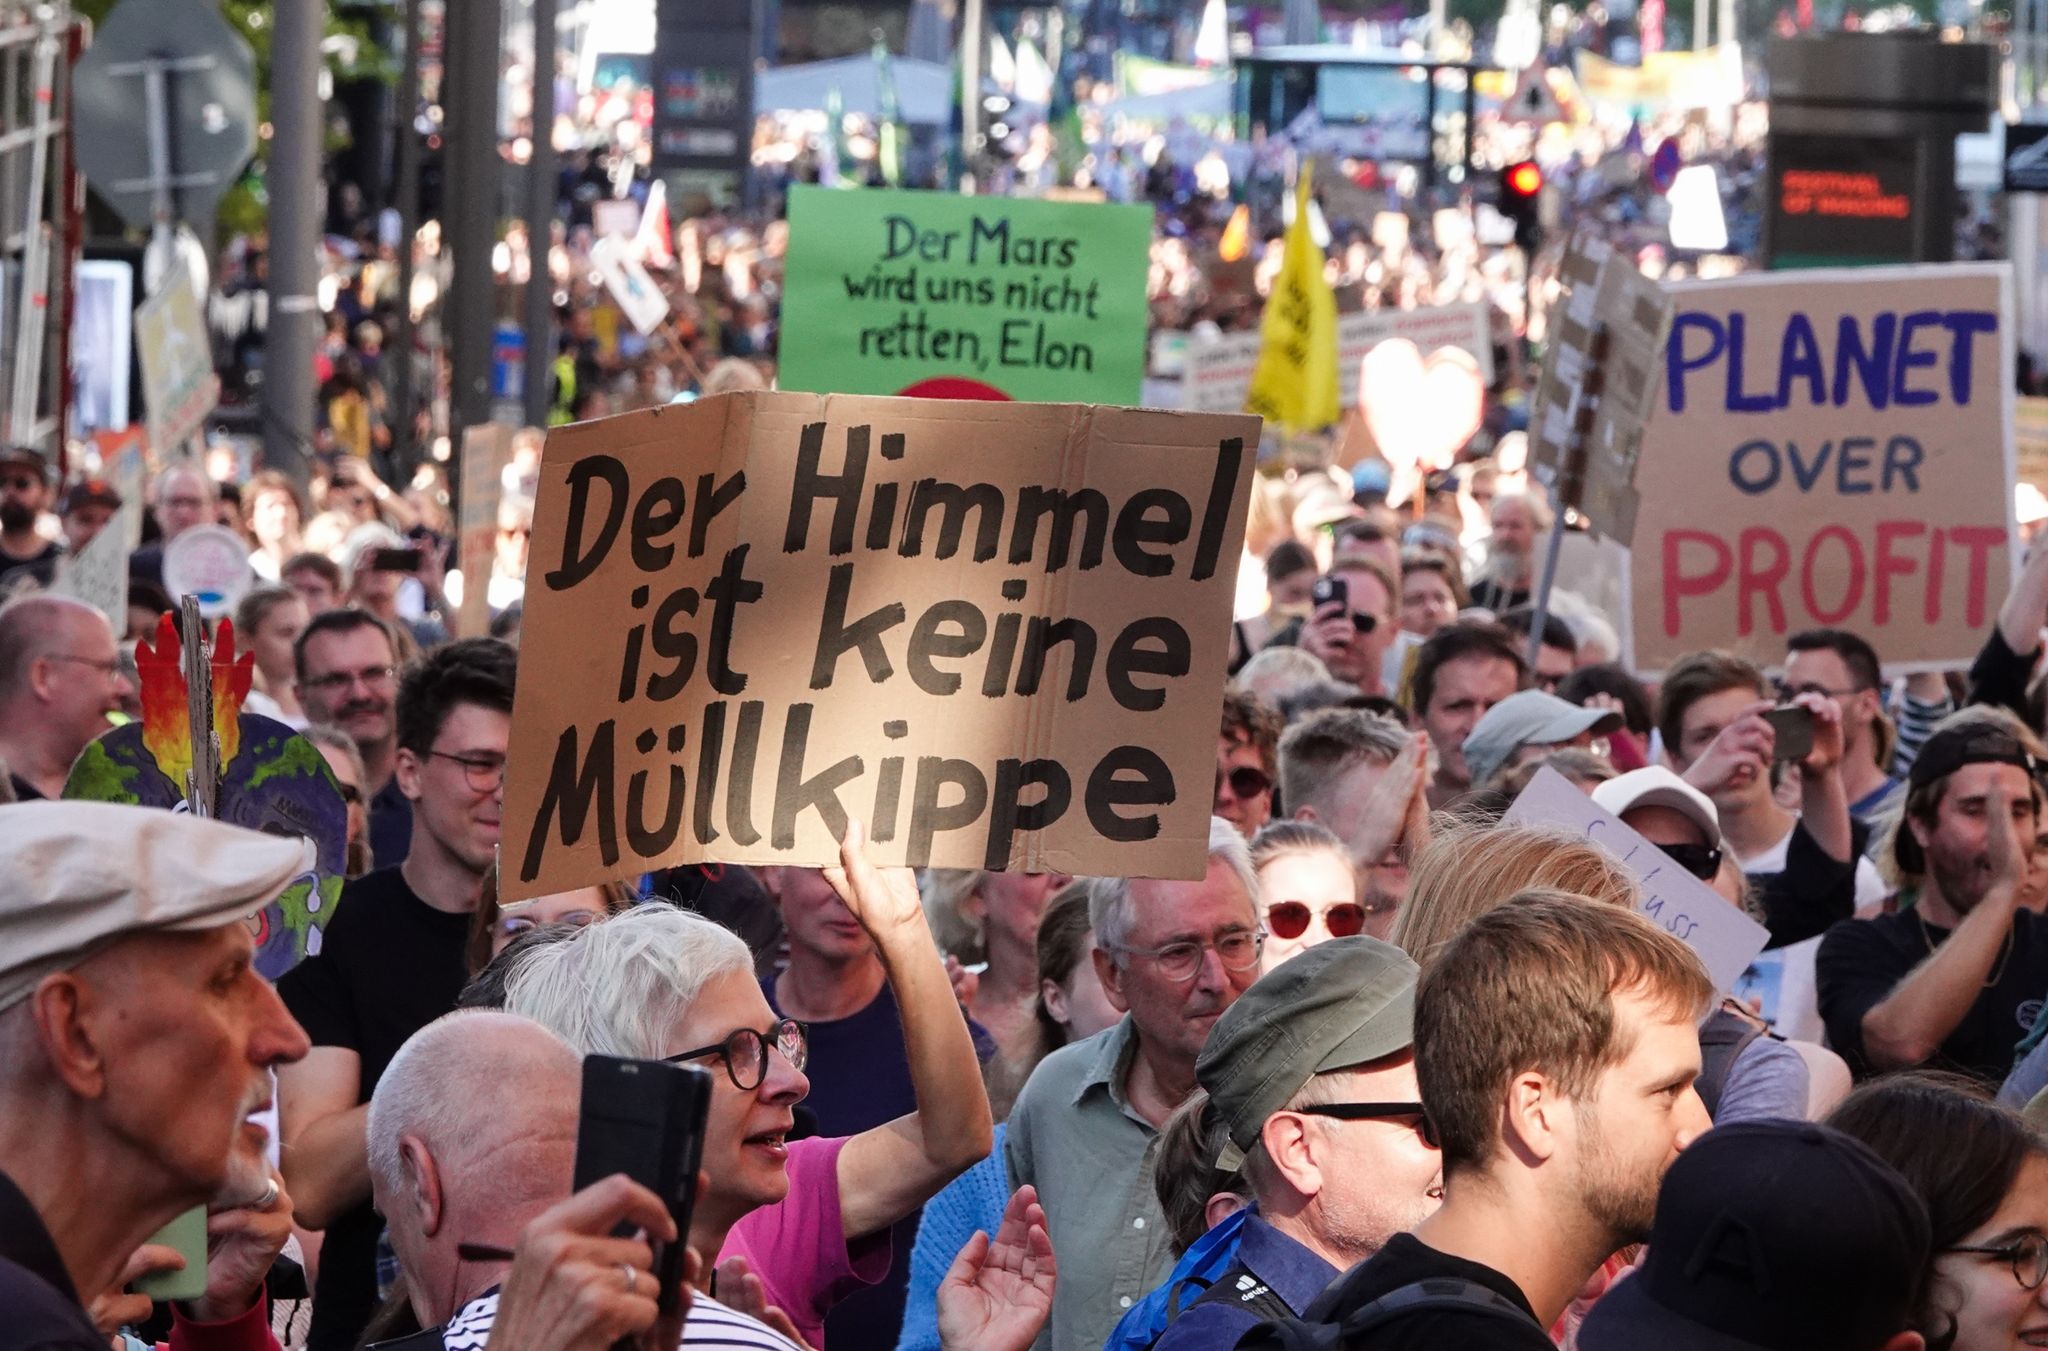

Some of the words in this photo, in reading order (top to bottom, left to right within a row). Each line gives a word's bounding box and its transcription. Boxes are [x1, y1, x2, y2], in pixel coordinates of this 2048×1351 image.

[842, 263, 917, 304] wird
[925, 276, 995, 305] uns
[1005, 273, 1099, 320] nicht
[881, 213, 960, 262] Der
[968, 214, 1079, 268] Mars
[859, 309, 989, 372] retten,
[1000, 318, 1094, 373] Elon
[1666, 311, 1998, 413] PLANET
[545, 454, 747, 591] Der
[783, 422, 1243, 581] Himmel
[1729, 434, 1925, 495] OVER
[618, 543, 764, 702] ist
[809, 562, 1192, 712] keine
[1662, 520, 2009, 638] PROFIT
[520, 701, 1176, 882] Müllkippe
